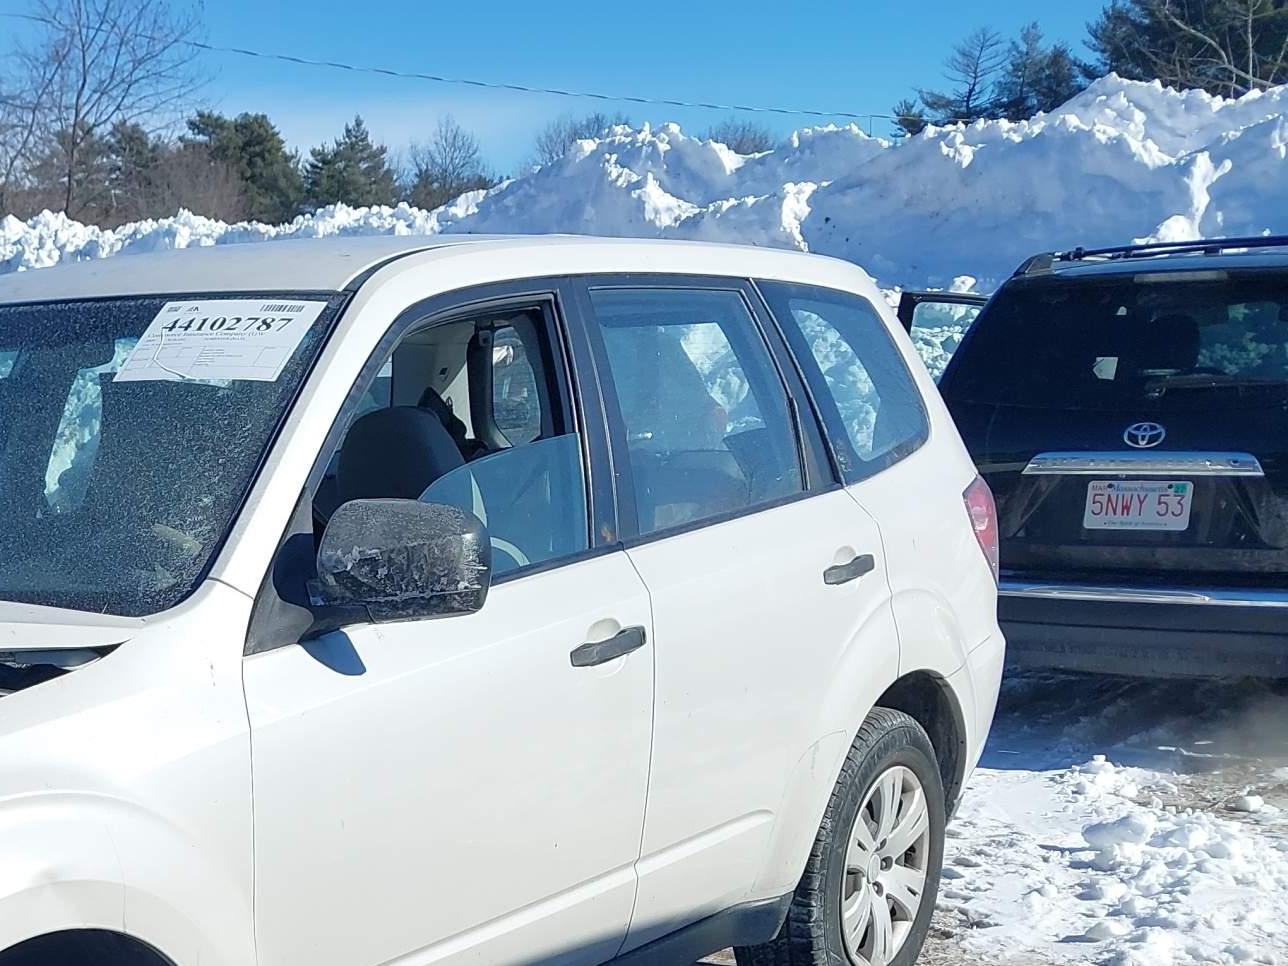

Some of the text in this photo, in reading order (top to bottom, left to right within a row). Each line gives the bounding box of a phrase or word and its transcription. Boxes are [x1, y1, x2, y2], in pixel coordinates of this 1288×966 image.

[162, 317, 294, 332] 44102787
[1091, 494, 1185, 516] 5NWY 53
